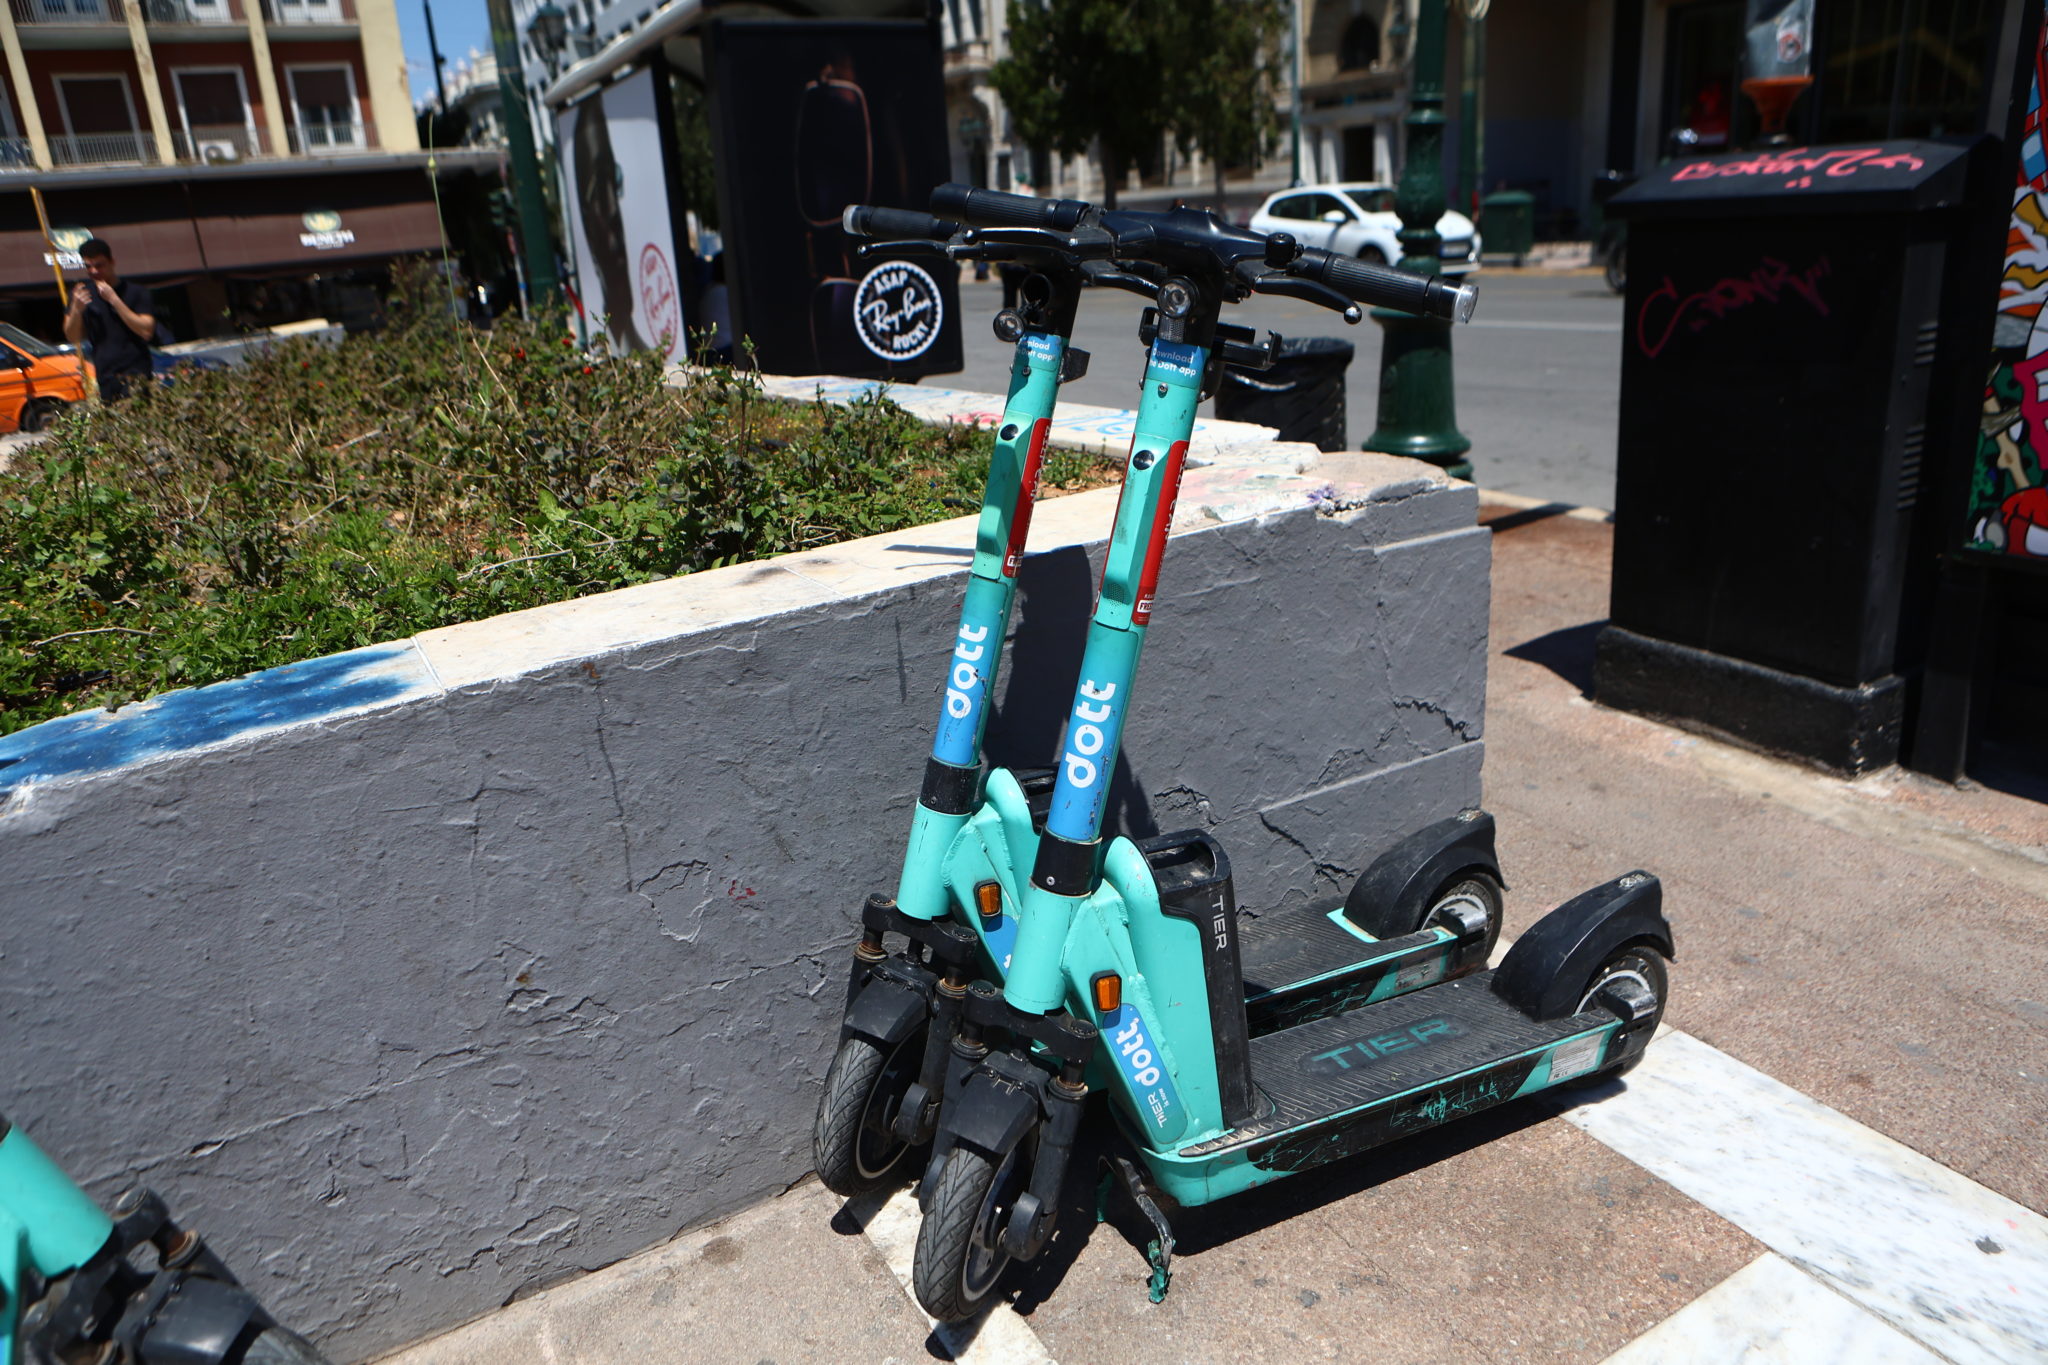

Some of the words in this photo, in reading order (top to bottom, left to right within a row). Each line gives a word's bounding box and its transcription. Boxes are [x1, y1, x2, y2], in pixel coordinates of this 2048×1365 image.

[1178, 366, 1197, 378] app
[946, 623, 988, 719] dott
[1065, 679, 1117, 789] dott
[1211, 894, 1228, 952] TIER
[1311, 1018, 1457, 1069] TIER
[1137, 1091, 1168, 1129] TIER
